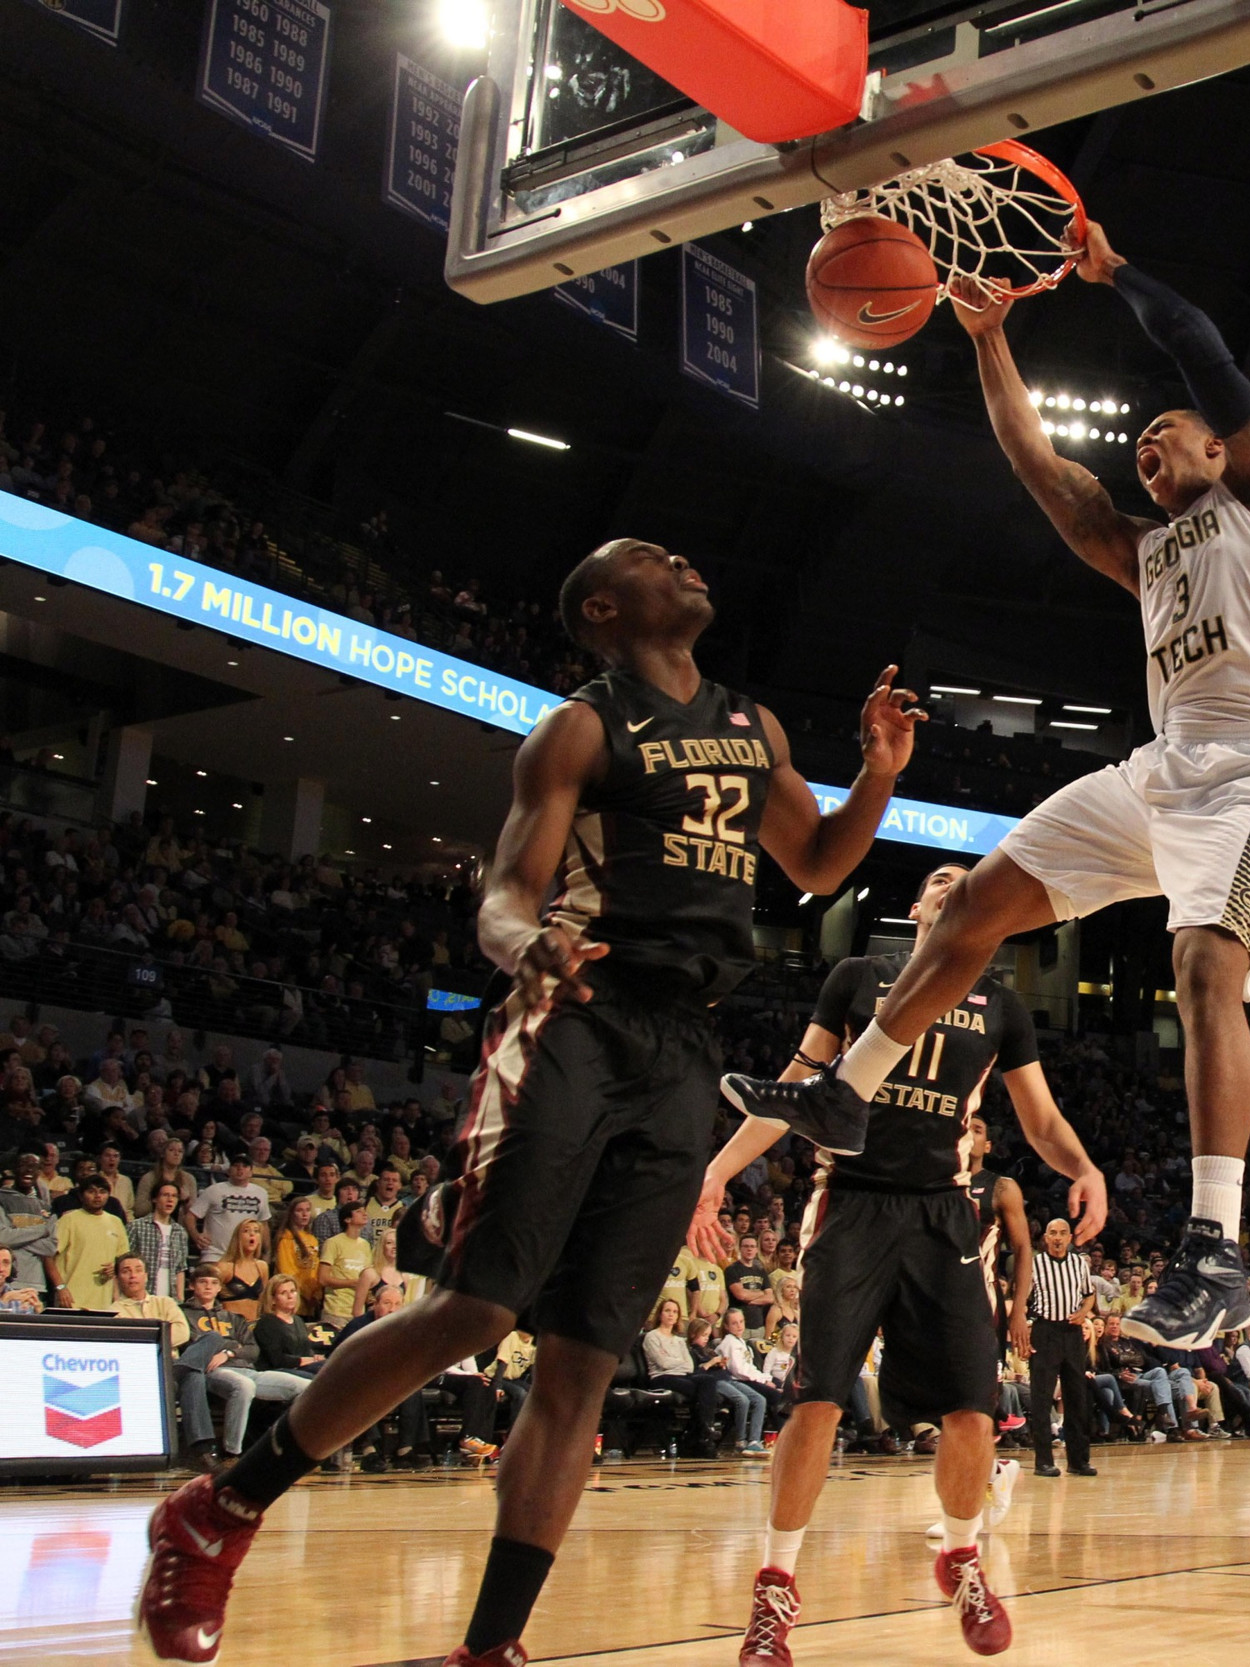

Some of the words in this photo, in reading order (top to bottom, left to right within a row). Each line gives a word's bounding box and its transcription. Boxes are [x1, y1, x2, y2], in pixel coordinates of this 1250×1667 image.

[233, 14, 265, 47] 1985
[276, 14, 308, 47] 1988
[230, 40, 262, 74] 1986
[273, 39, 305, 72] 1989
[227, 67, 259, 99] 1987
[270, 66, 302, 98] 1990
[267, 92, 297, 124] 1991
[412, 96, 441, 127] 1992
[410, 120, 439, 151] 1993
[409, 145, 438, 175] 1996
[407, 170, 437, 200] 2001
[705, 285, 733, 316] 1985
[706, 313, 734, 345] 1990
[707, 341, 738, 373] 2004
[1172, 573, 1189, 624] 3
[149, 563, 195, 601] 1.7
[201, 581, 341, 656] MILLION
[349, 635, 434, 688] HOPE
[1151, 615, 1229, 684] TECH
[637, 738, 770, 774] FLORIDA
[681, 773, 750, 844] 32
[662, 833, 756, 886] STATE
[135, 968, 157, 982] 109
[907, 1031, 945, 1080] 11
[874, 1081, 958, 1117] STATE
[41, 1353, 120, 1372] Chevron
